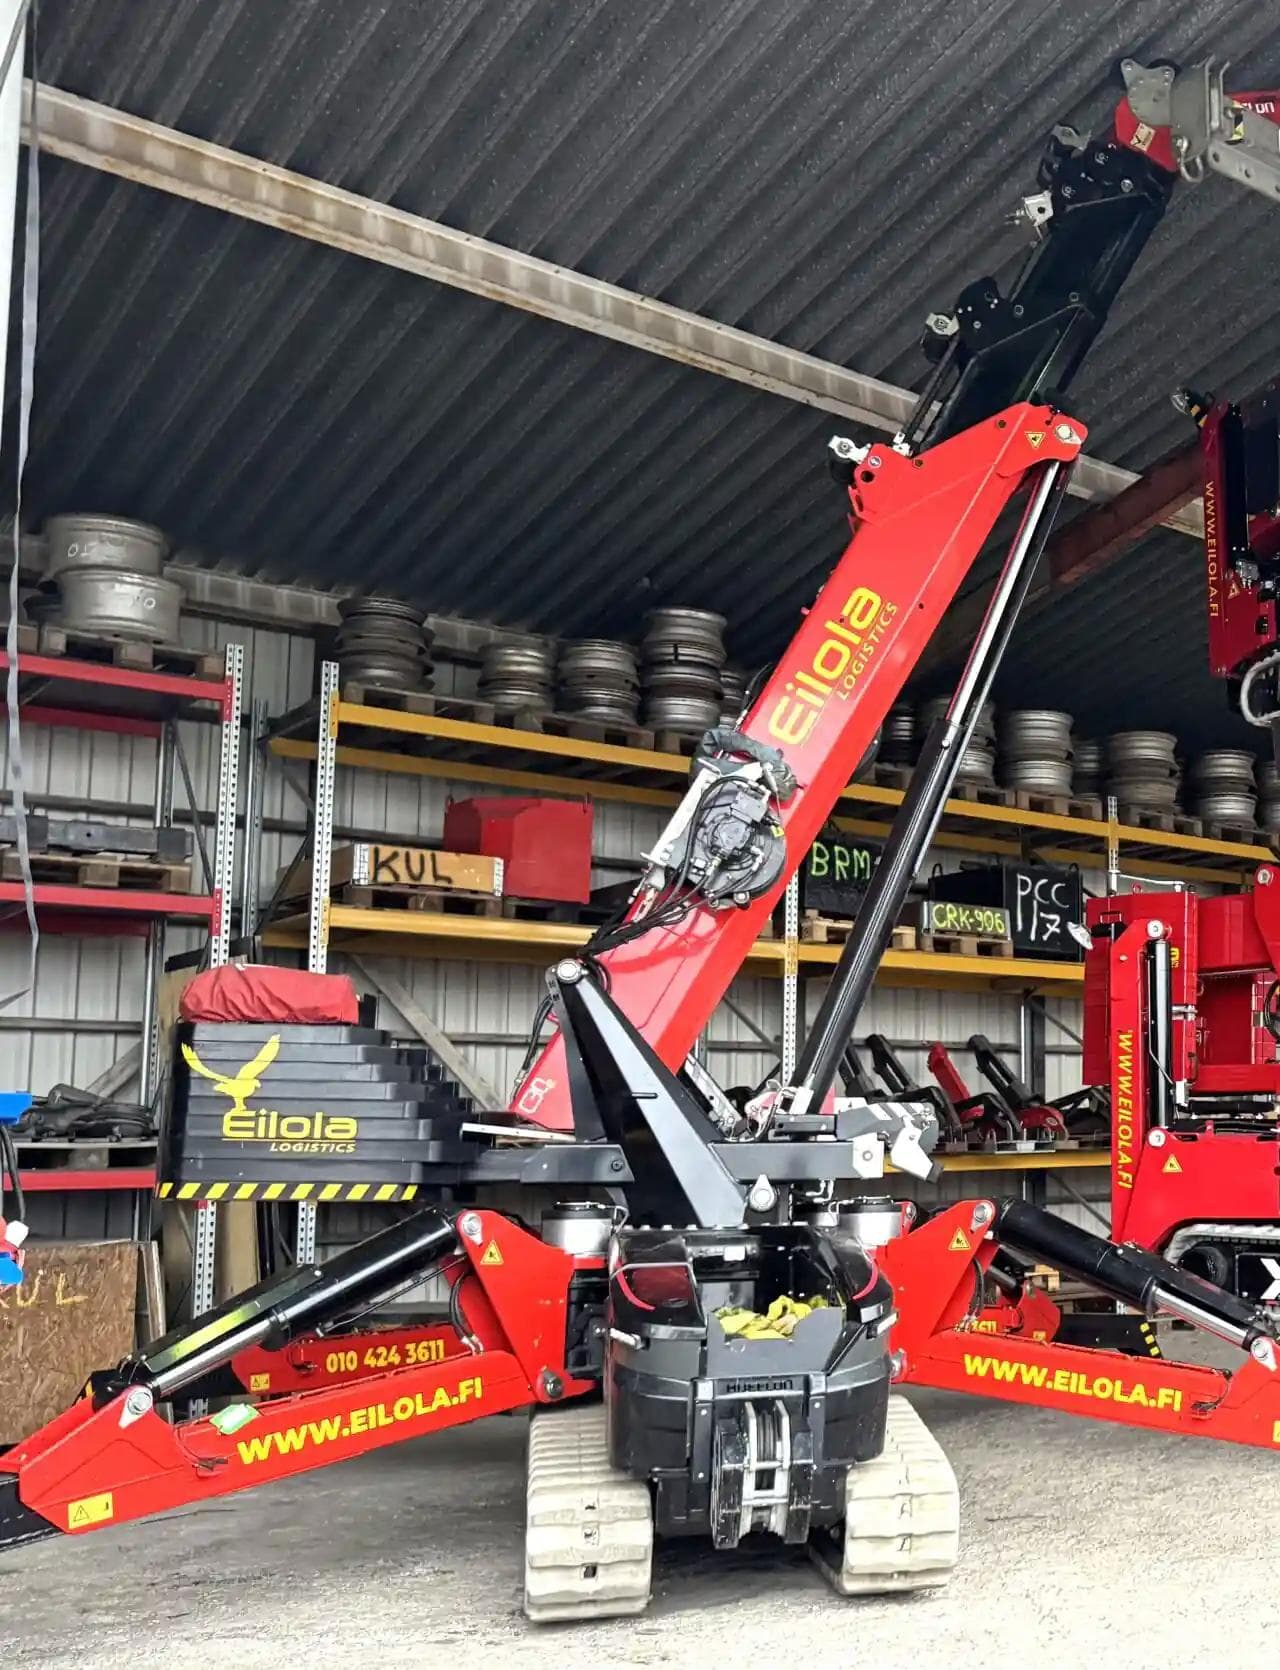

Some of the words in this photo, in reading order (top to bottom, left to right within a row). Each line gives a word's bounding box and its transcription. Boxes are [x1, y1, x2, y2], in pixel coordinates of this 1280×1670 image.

[1205, 480, 1219, 617] WWW.EILOLA.FI
[768, 586, 882, 745] Eilola
[836, 602, 898, 701] LOGISTICS
[373, 846, 453, 885] KUL
[811, 841, 871, 881] BRM
[932, 902, 1006, 934] CRK-906
[1015, 873, 1070, 932] PCC
[222, 1108, 358, 1139] Eilola
[1117, 1030, 1133, 1190] WWW.EILOLA.FI
[269, 1142, 356, 1153] LOGISTICS
[0, 1270, 88, 1308] UL
[326, 1352, 358, 1373] 010
[364, 1346, 401, 1368] 424
[405, 1339, 445, 1364] 3611
[963, 1353, 1183, 1413] WWW.EILOLA.FI
[237, 1376, 483, 1465] WWW.EILOLA.FI
